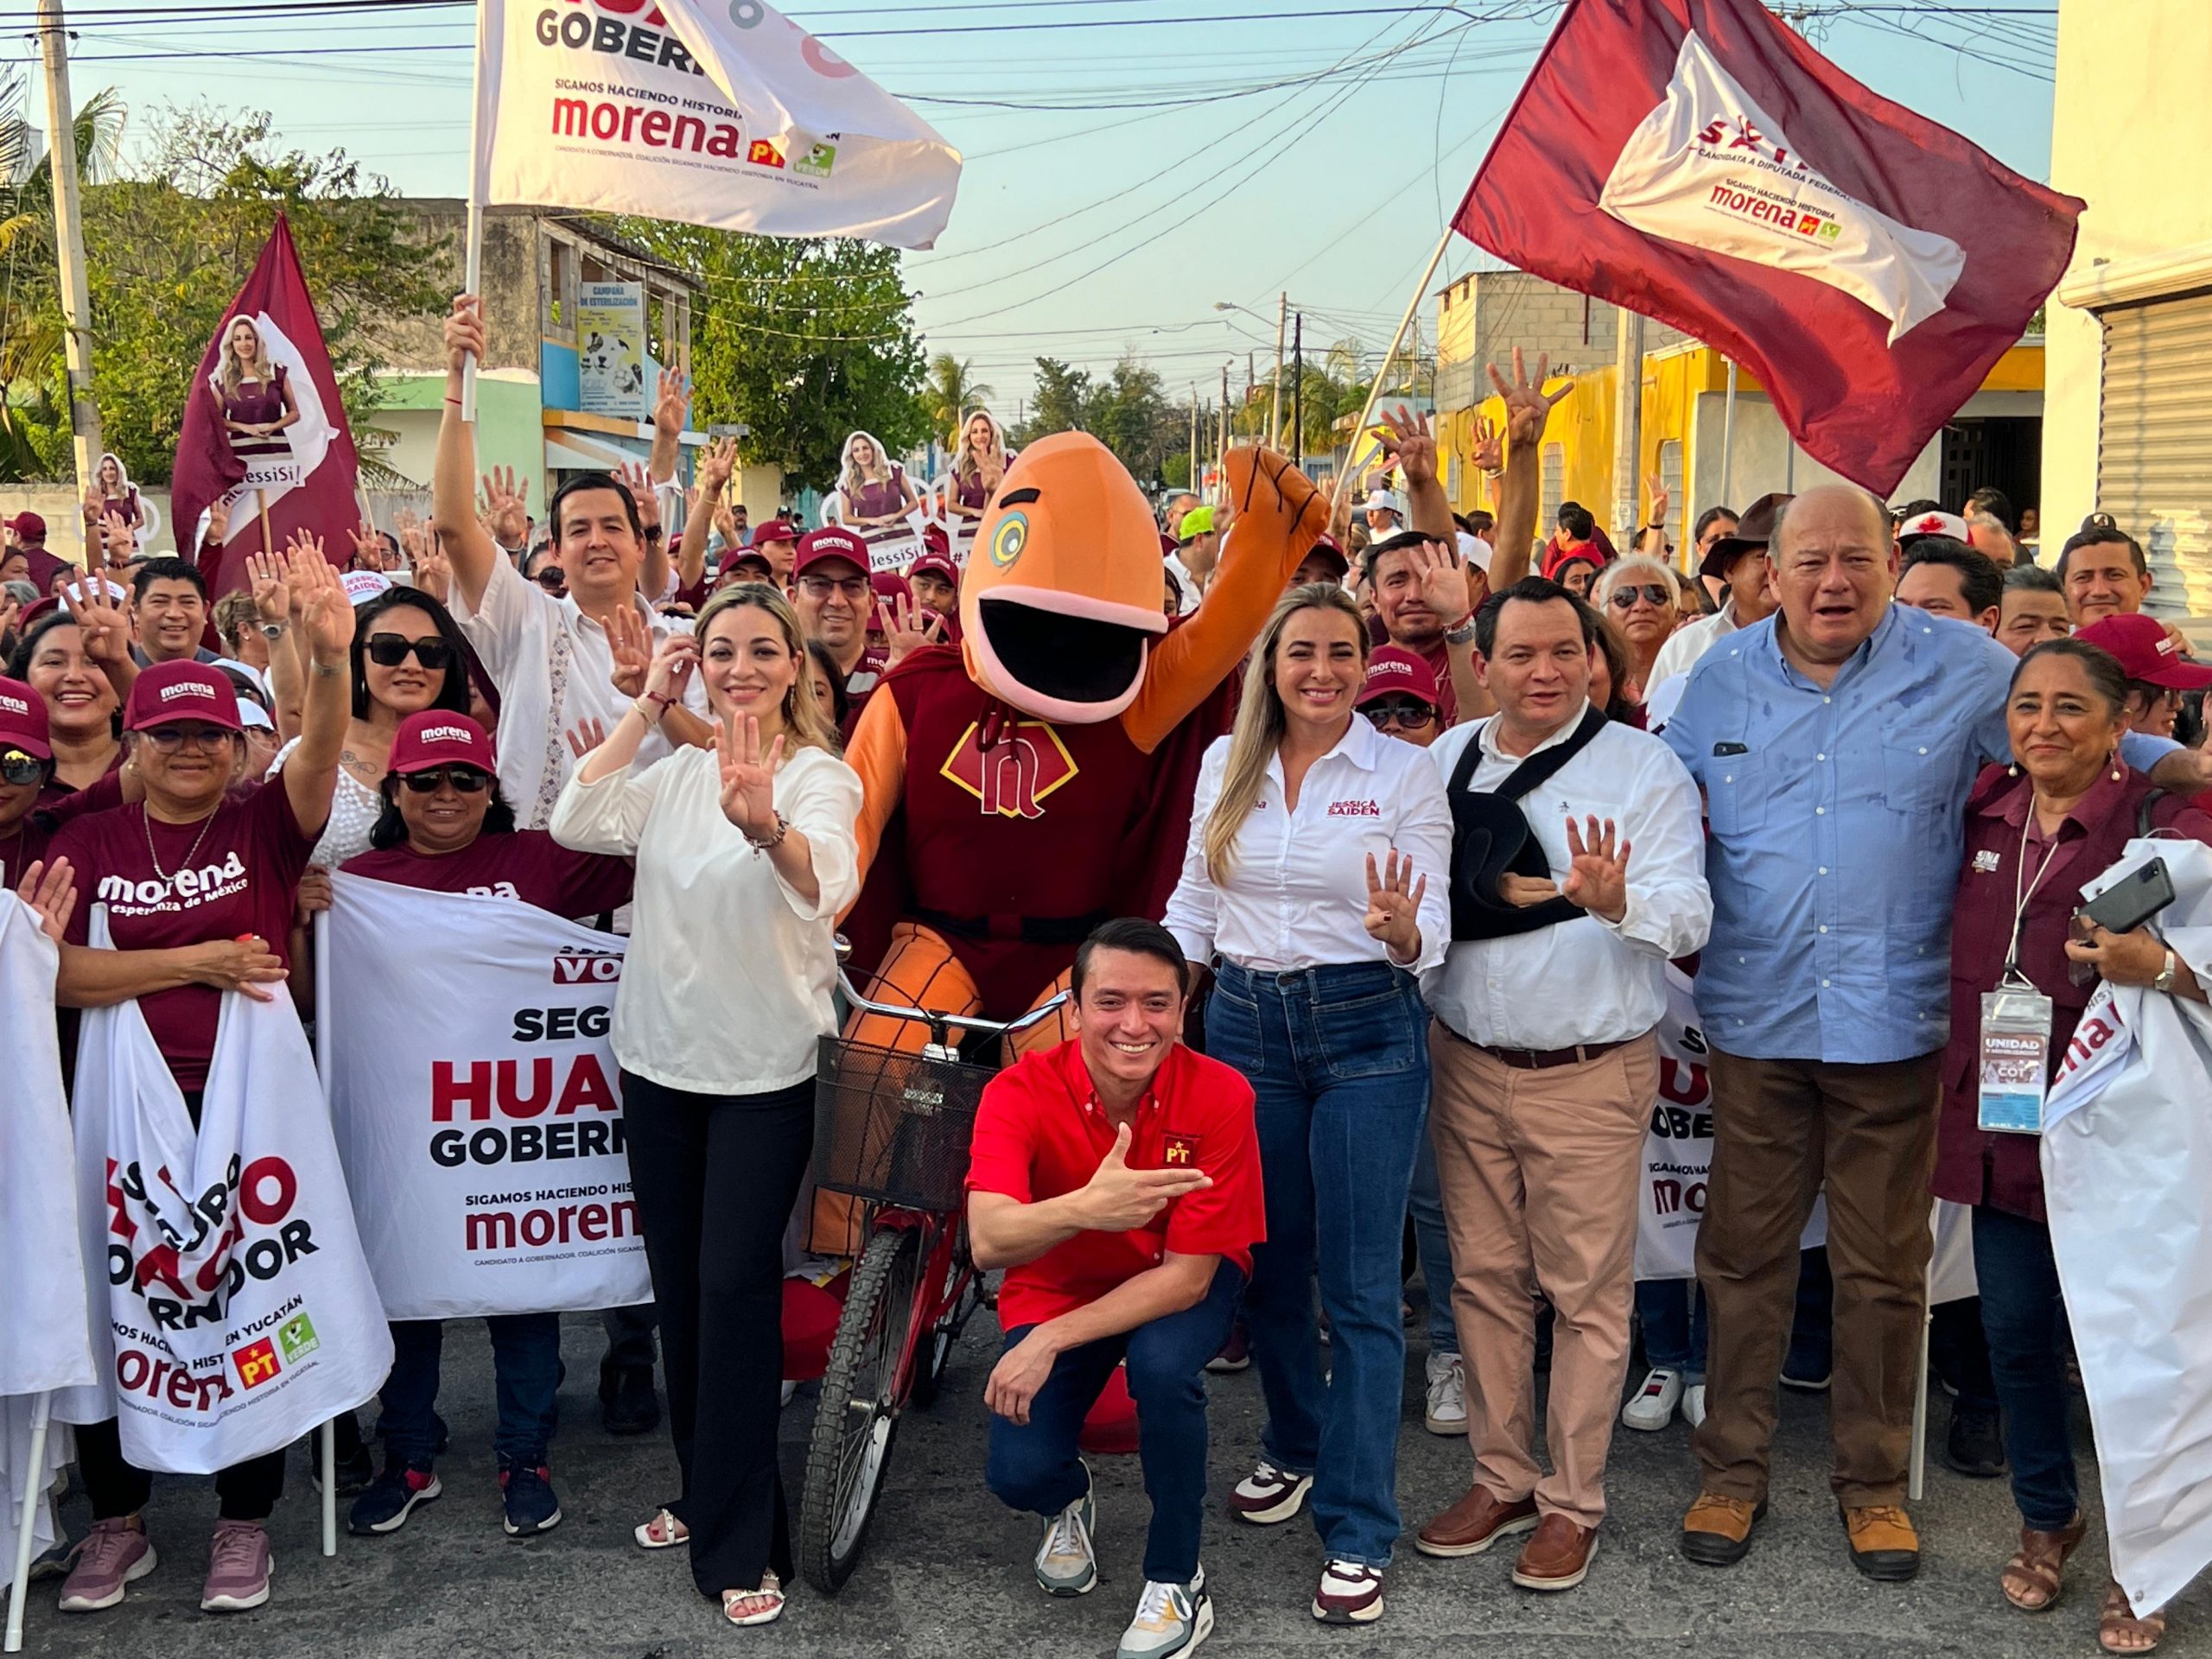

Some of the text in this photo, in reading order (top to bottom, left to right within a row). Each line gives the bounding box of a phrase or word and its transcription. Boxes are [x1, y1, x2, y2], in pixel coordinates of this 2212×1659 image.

[555, 79, 604, 93] SIGAMOS
[607, 85, 678, 105] HACIENDO
[552, 98, 740, 159] morena
[1698, 148, 1746, 164] CANDIDATA
[1757, 160, 1806, 183] DIPUTADA
[1709, 185, 1798, 230] morena
[1726, 178, 1836, 220] SIGAMOS HACIENDO HISTORIA
[1368, 661, 1412, 675] morena
[160, 682, 215, 698] morena
[421, 726, 472, 740] morena
[1327, 806, 1380, 817] SAIDEN
[1331, 799, 1377, 808] JESSICA
[98, 851, 246, 905] morena
[184, 898, 201, 908] de
[205, 878, 249, 902] México
[1986, 1038, 2040, 1050] UNIDAD
[1998, 1067, 2026, 1078] COT
[432, 1053, 623, 1122] HUA
[1166, 1147, 1190, 1163] PT
[466, 1191, 531, 1206] SIGAMOS
[536, 1185, 608, 1201] HACIENDO
[474, 1257, 518, 1267] CANDIDATO
[226, 1294, 303, 1347] EN YUCATÁN
[287, 1336, 320, 1363] VERDE
[242, 1351, 275, 1386] PT
